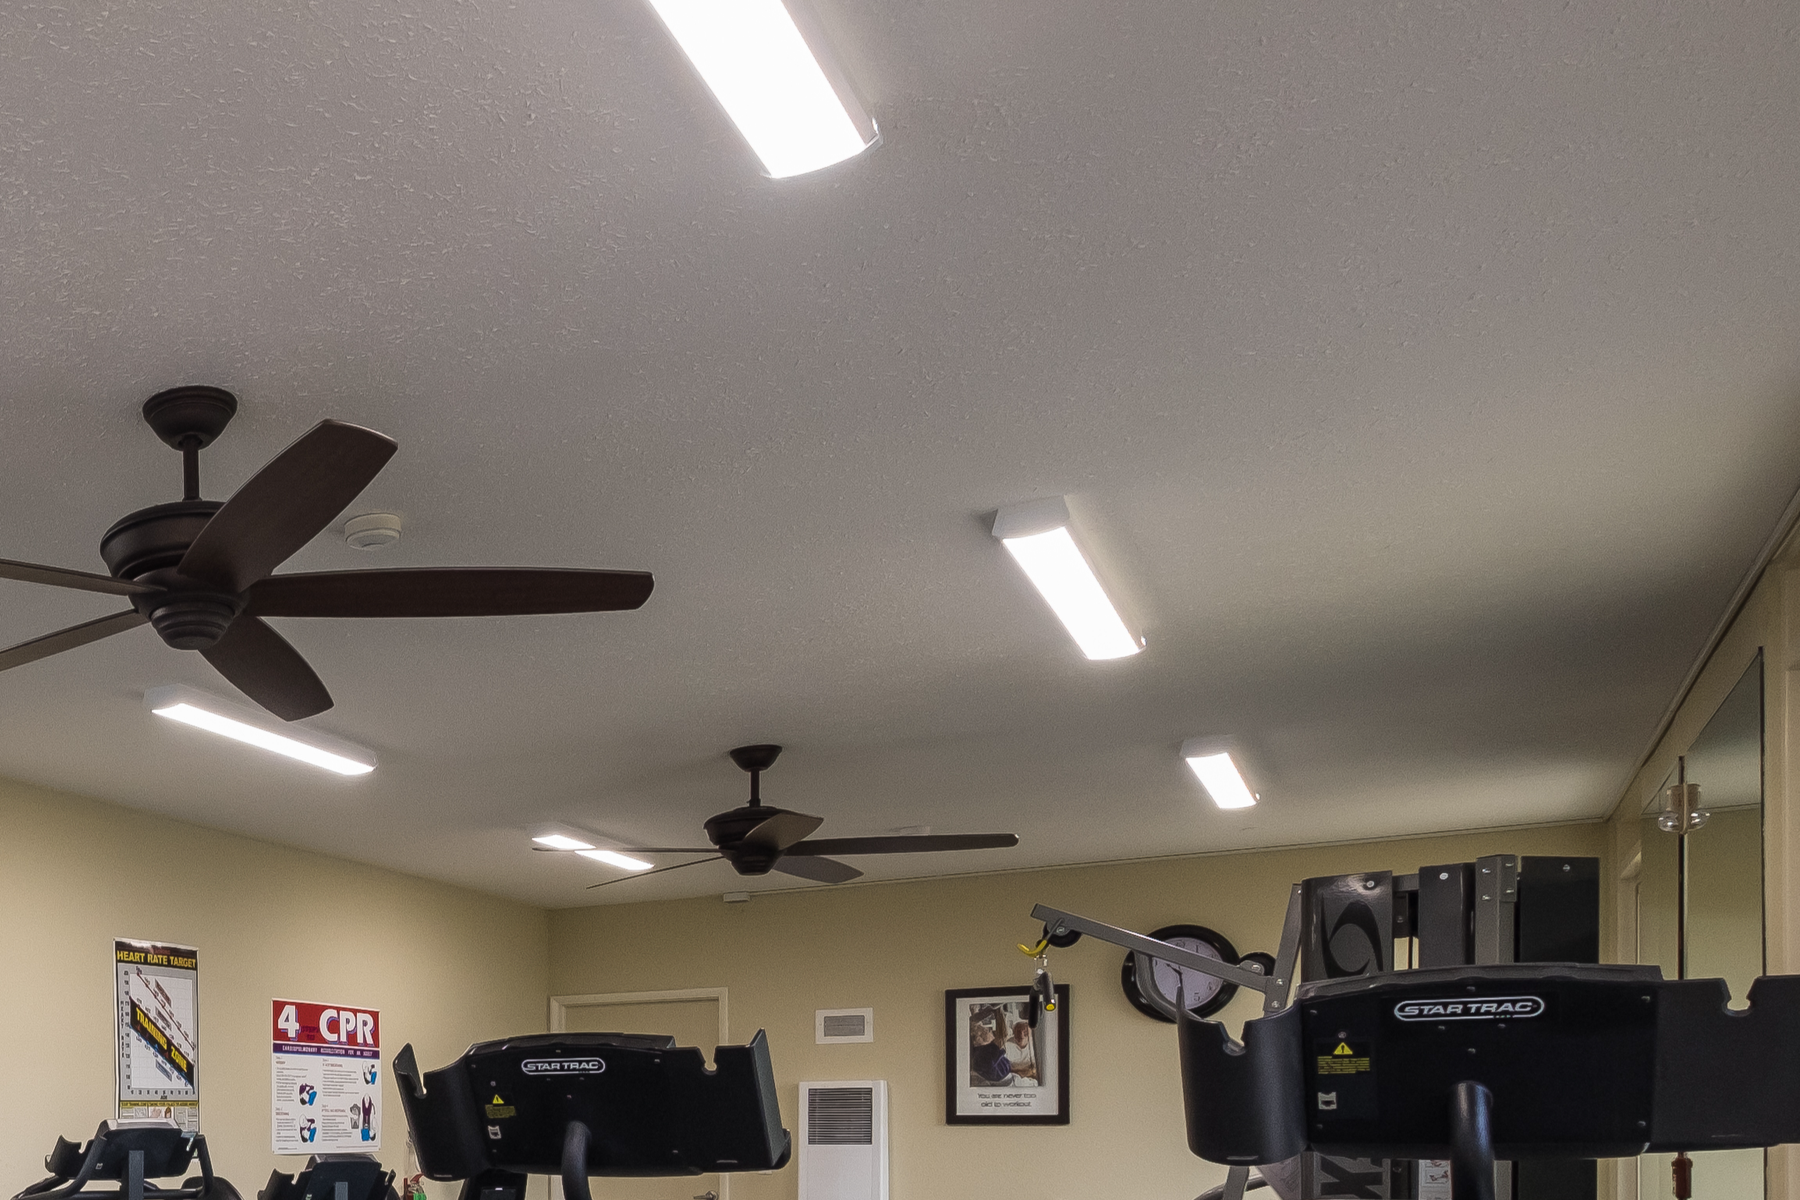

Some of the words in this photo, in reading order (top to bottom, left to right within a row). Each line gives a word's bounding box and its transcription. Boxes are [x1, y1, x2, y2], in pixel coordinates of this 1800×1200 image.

[117, 950, 145, 963] HEART
[147, 953, 168, 965] RATE
[169, 956, 196, 968] TARGET
[1398, 1004, 1463, 1015] STAR
[1466, 1002, 1533, 1013] TRAC
[136, 1007, 167, 1050] TRAINING
[277, 1004, 301, 1040] 4
[319, 1008, 375, 1046] CPR
[171, 1045, 187, 1072] ZONE
[523, 1062, 560, 1071] STAR
[562, 1061, 599, 1070] TRAC
